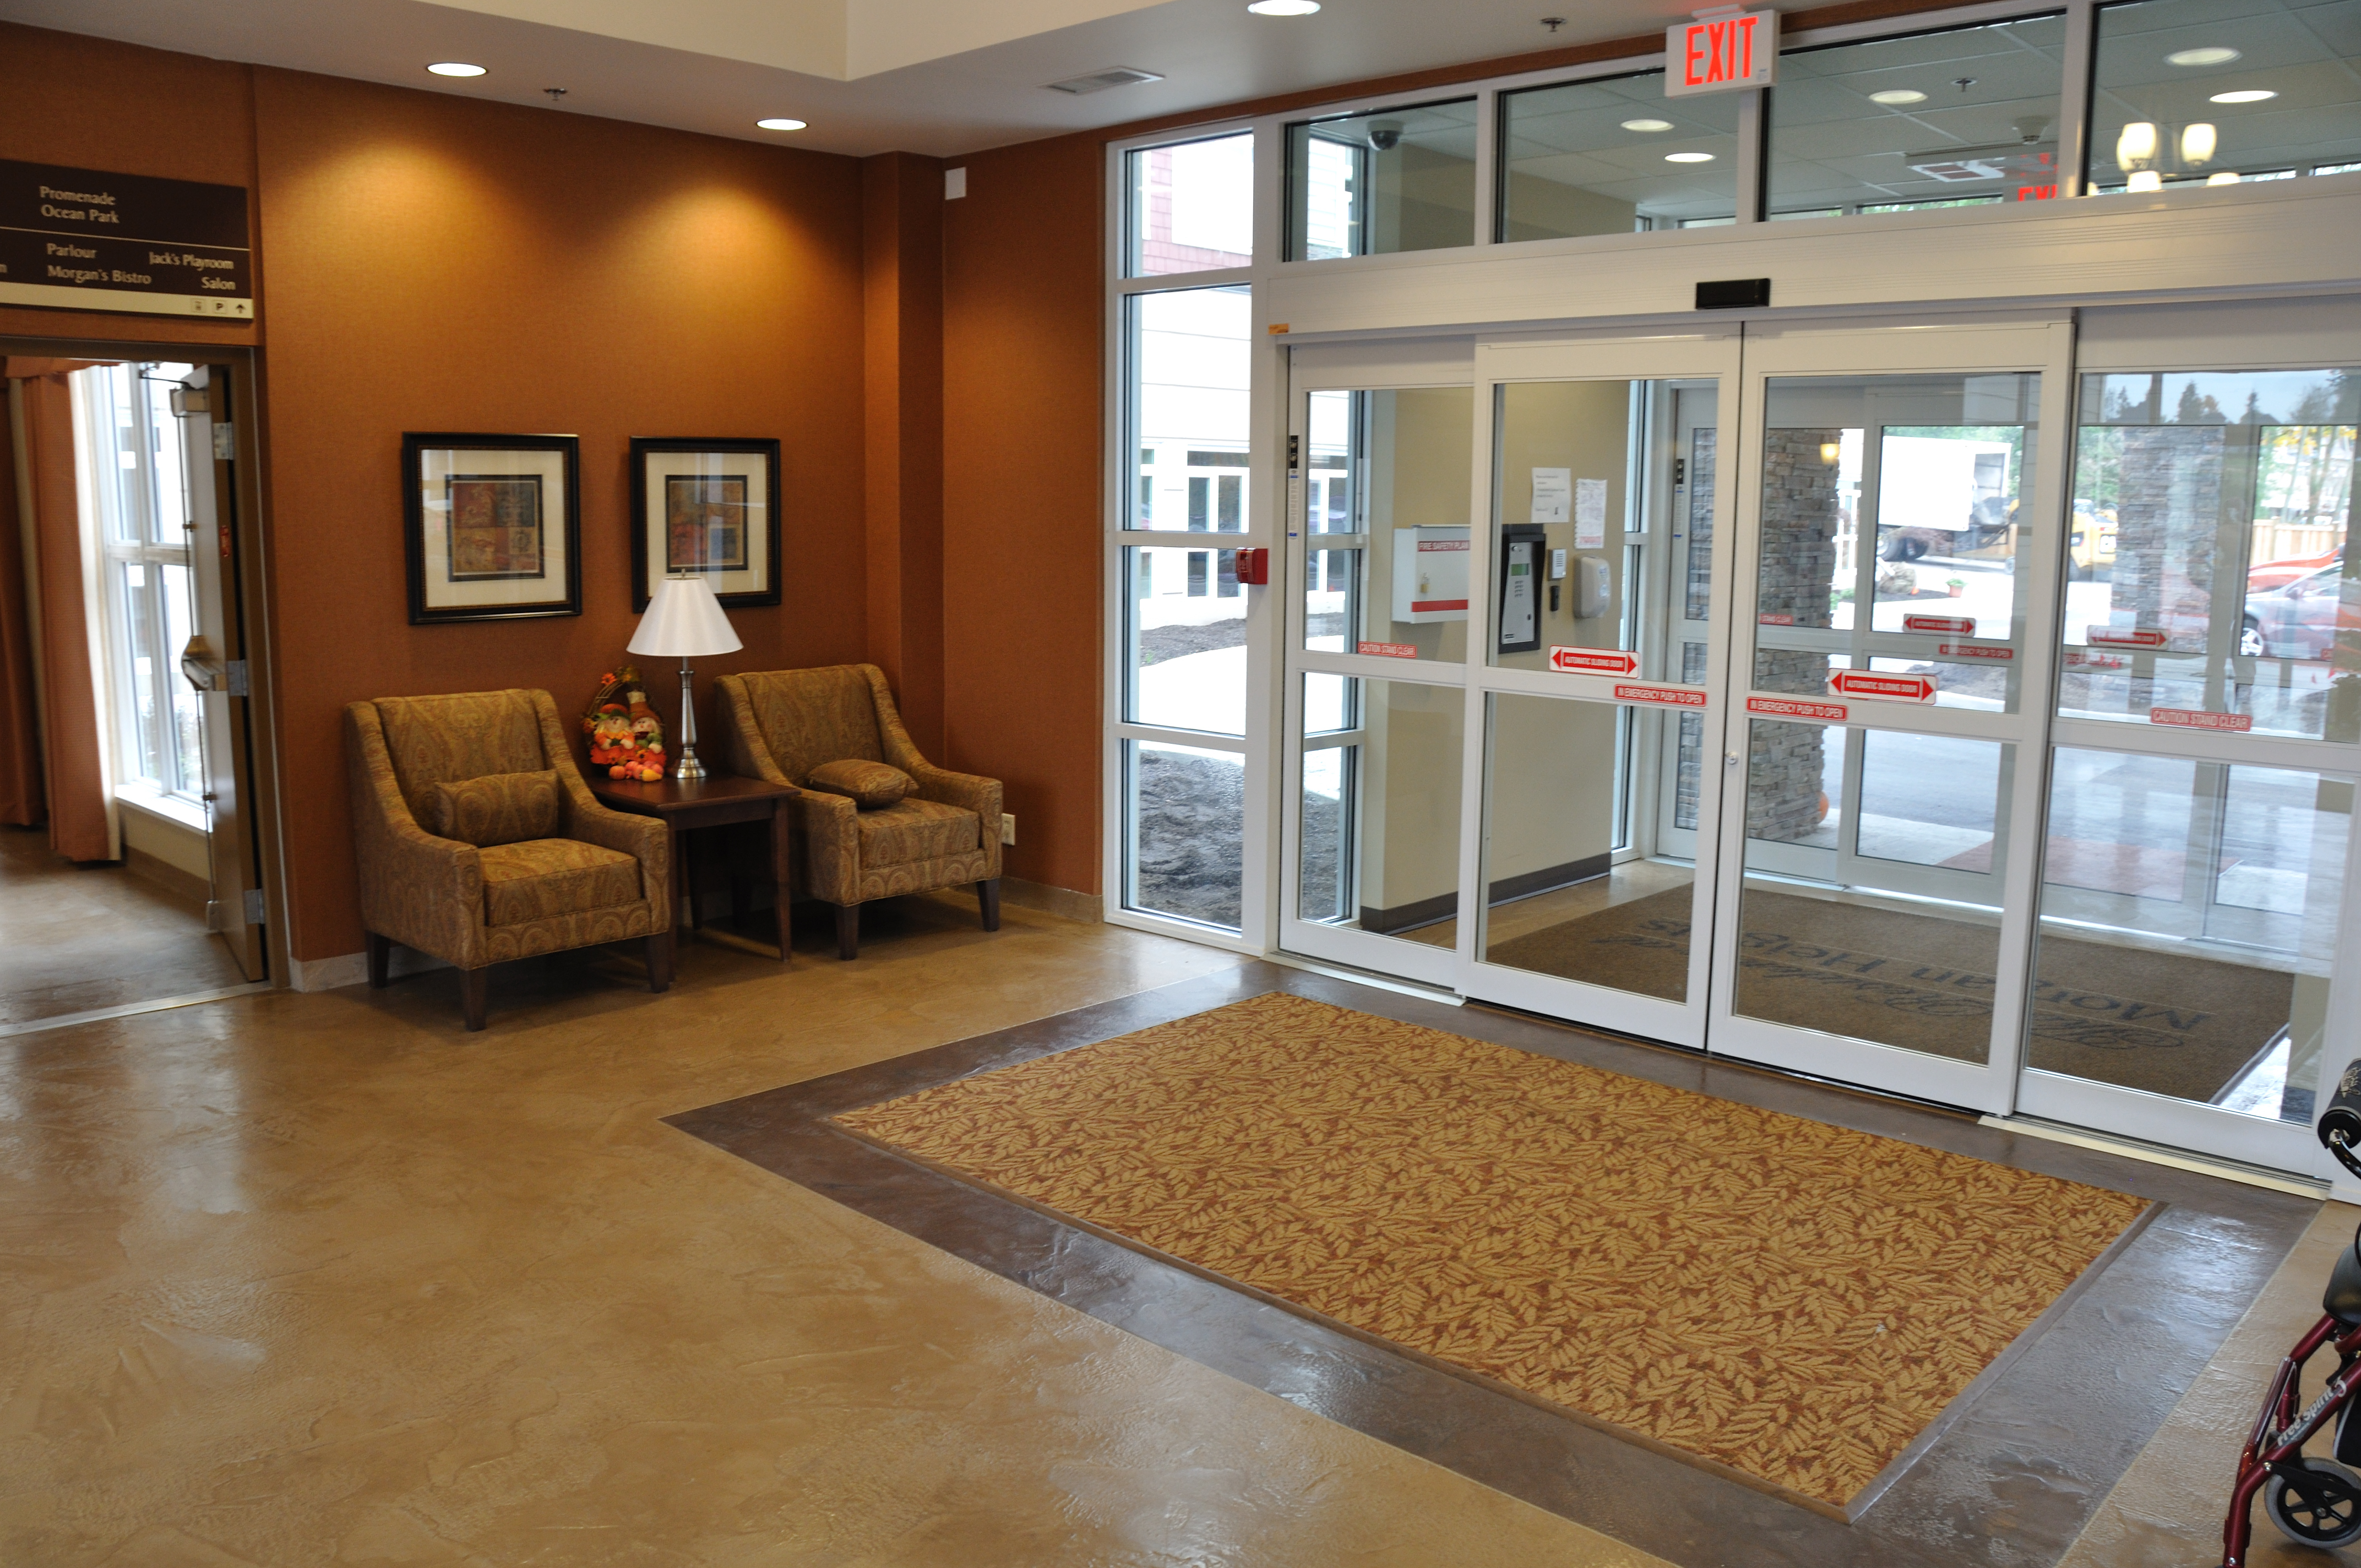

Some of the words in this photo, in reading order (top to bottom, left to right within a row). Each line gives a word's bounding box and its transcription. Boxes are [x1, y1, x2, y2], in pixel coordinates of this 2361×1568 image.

[1685, 15, 1759, 86] EXIT
[39, 186, 116, 206] Promenade
[41, 204, 85, 220] Ocean
[89, 209, 120, 224] Park
[46, 242, 97, 259] Parlour
[148, 251, 181, 266] Jack's
[182, 254, 235, 271] Playroom
[47, 264, 109, 284] Morgan's
[112, 269, 153, 285] Bistro
[200, 276, 237, 291] Salon
[1419, 542, 1433, 551] FIRE
[1454, 541, 1469, 549] PLAN
[1359, 643, 1380, 653] CAUTION
[1381, 645, 1397, 655] STAND
[1397, 646, 1415, 656] CLEAR
[1565, 656, 1591, 665] AUTOMATIC
[1591, 658, 1609, 667] SLIDING
[1609, 660, 1624, 668] DOOR
[1846, 679, 1878, 690] AUTOMATIC
[1878, 682, 1901, 692] SLIDING
[1901, 684, 1918, 693] DOOR
[1618, 687, 1624, 696] IN
[1624, 688, 1660, 700] EMERGENCY
[1660, 691, 1677, 701] PUSH
[1677, 693, 1685, 703] TO
[1685, 694, 1702, 704] OPEN
[1750, 700, 1756, 710] IN
[1758, 700, 1796, 714] EMERGENCY
[1797, 704, 1815, 715] PUSH
[1815, 706, 1824, 716] TO
[1825, 707, 1843, 718] OPEN
[2153, 710, 2189, 724] CAUTION
[2190, 714, 2218, 726] STAND
[2219, 716, 2249, 728] CLEAR
[1639, 919, 1887, 974] Heigts
[1910, 968, 2211, 1031] Moran
[2277, 1418, 2302, 1447] Free
